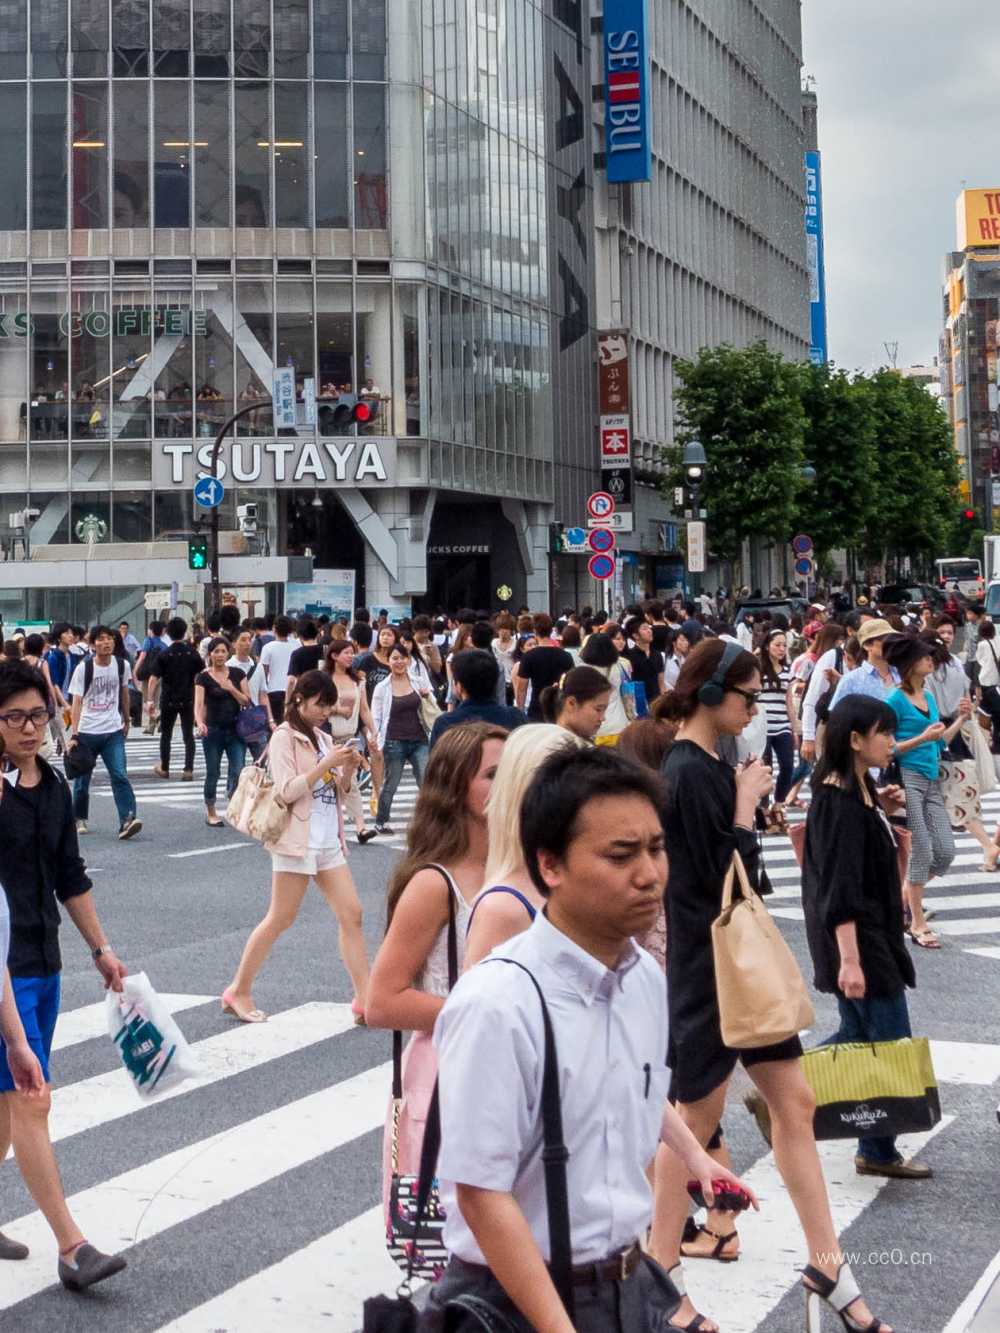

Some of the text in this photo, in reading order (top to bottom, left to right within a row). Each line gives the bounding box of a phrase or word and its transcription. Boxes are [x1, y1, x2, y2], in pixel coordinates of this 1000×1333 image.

[607, 29, 643, 154] SEIBU
[59, 309, 208, 338] COFFEE
[605, 432, 625, 452] 本
[162, 442, 388, 482] TSUTAYA
